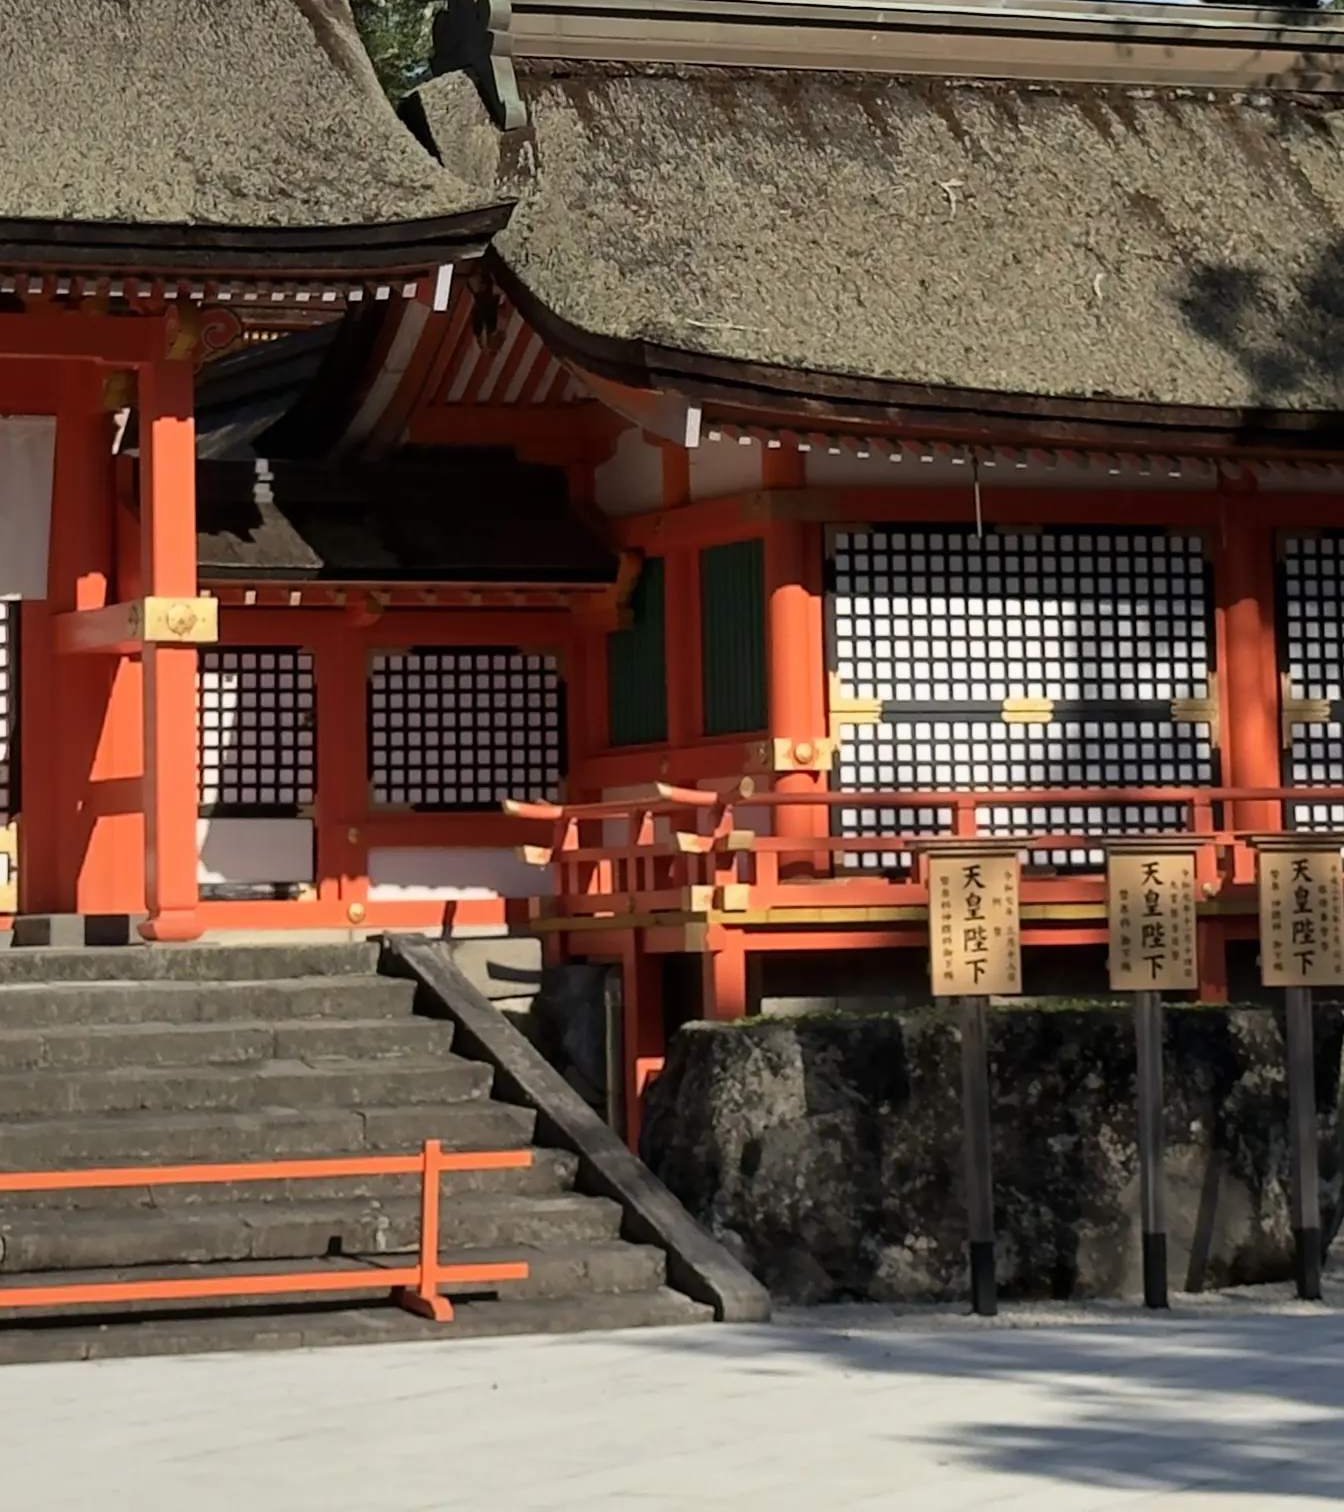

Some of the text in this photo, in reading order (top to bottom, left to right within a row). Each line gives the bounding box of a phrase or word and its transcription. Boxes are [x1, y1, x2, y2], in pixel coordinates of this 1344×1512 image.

[962, 864, 989, 985] 天皇陛下
[1141, 861, 1167, 980] 天皇陛下
[1291, 858, 1316, 977] 天皇陛下
